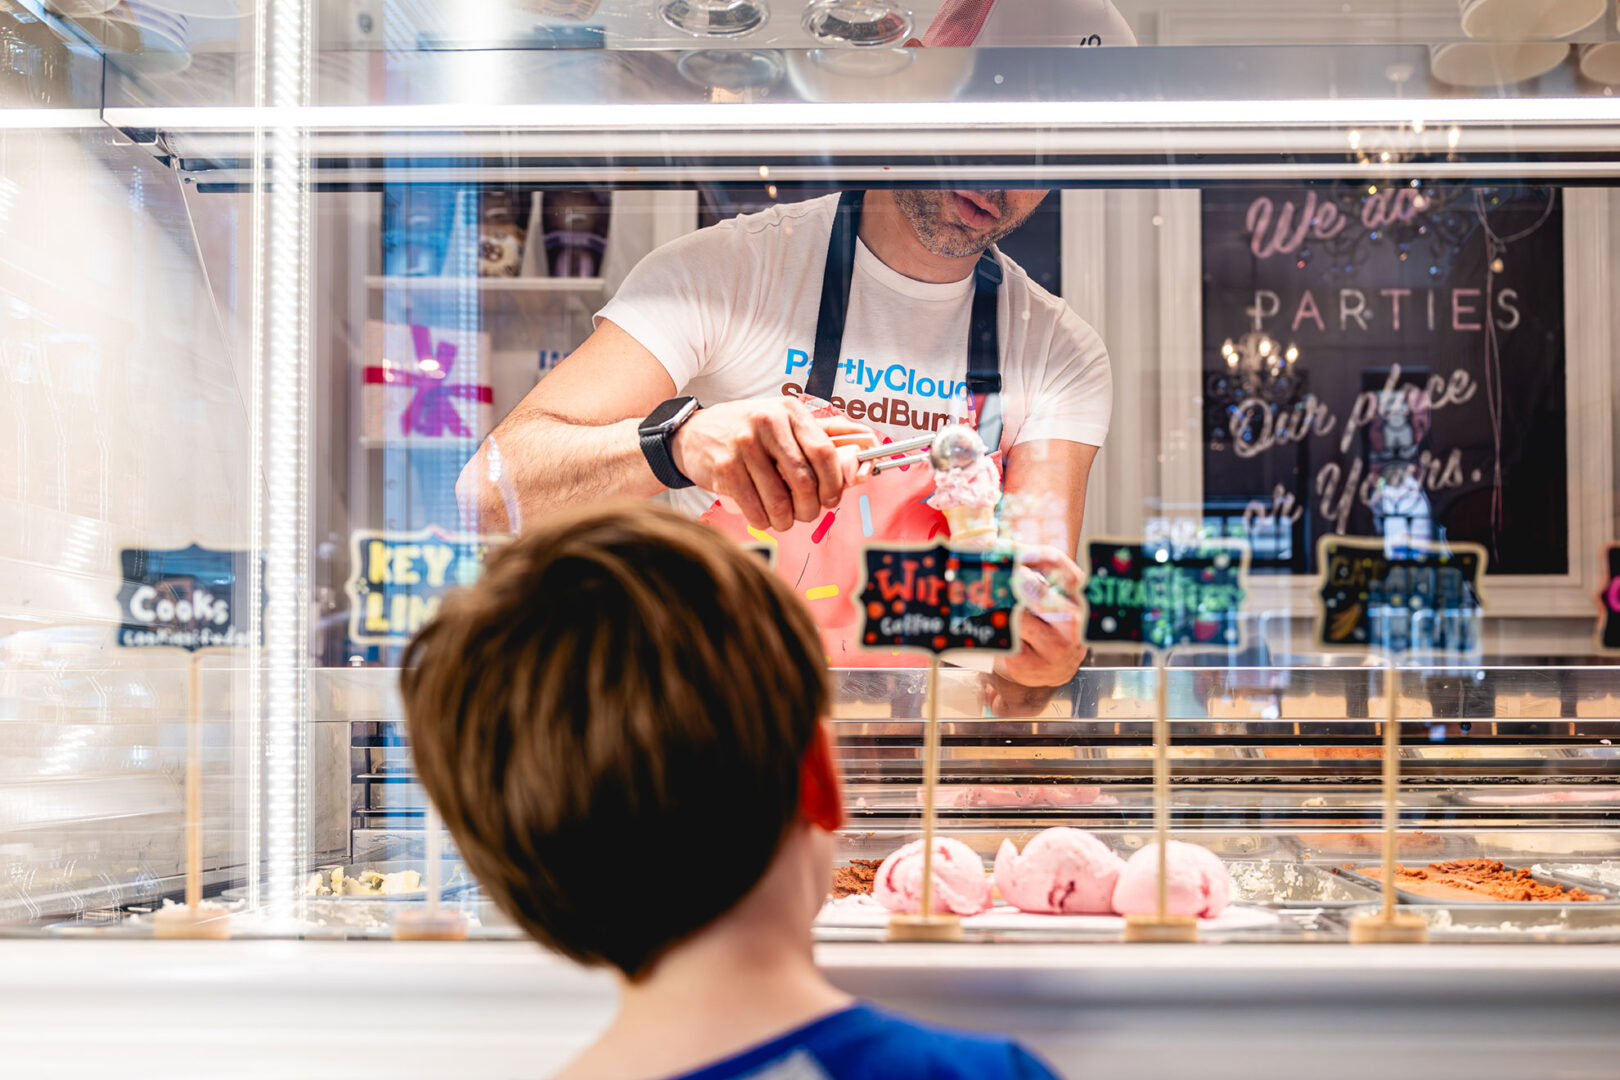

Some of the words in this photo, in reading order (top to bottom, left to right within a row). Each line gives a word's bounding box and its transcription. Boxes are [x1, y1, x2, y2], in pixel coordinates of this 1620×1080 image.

[1246, 188, 1346, 258] We
[1361, 187, 1430, 229] do
[1253, 287, 1521, 332] PARTIES
[1229, 393, 1336, 458] Our
[1340, 362, 1478, 453] place
[1242, 483, 1304, 535] or
[1316, 447, 1482, 536] Yors.
[368, 540, 455, 587] KEY
[874, 559, 997, 608] Wired
[129, 585, 229, 624] Cooks
[366, 592, 444, 633] LIM
[880, 613, 944, 636] Coffee
[949, 616, 995, 644] Chip
